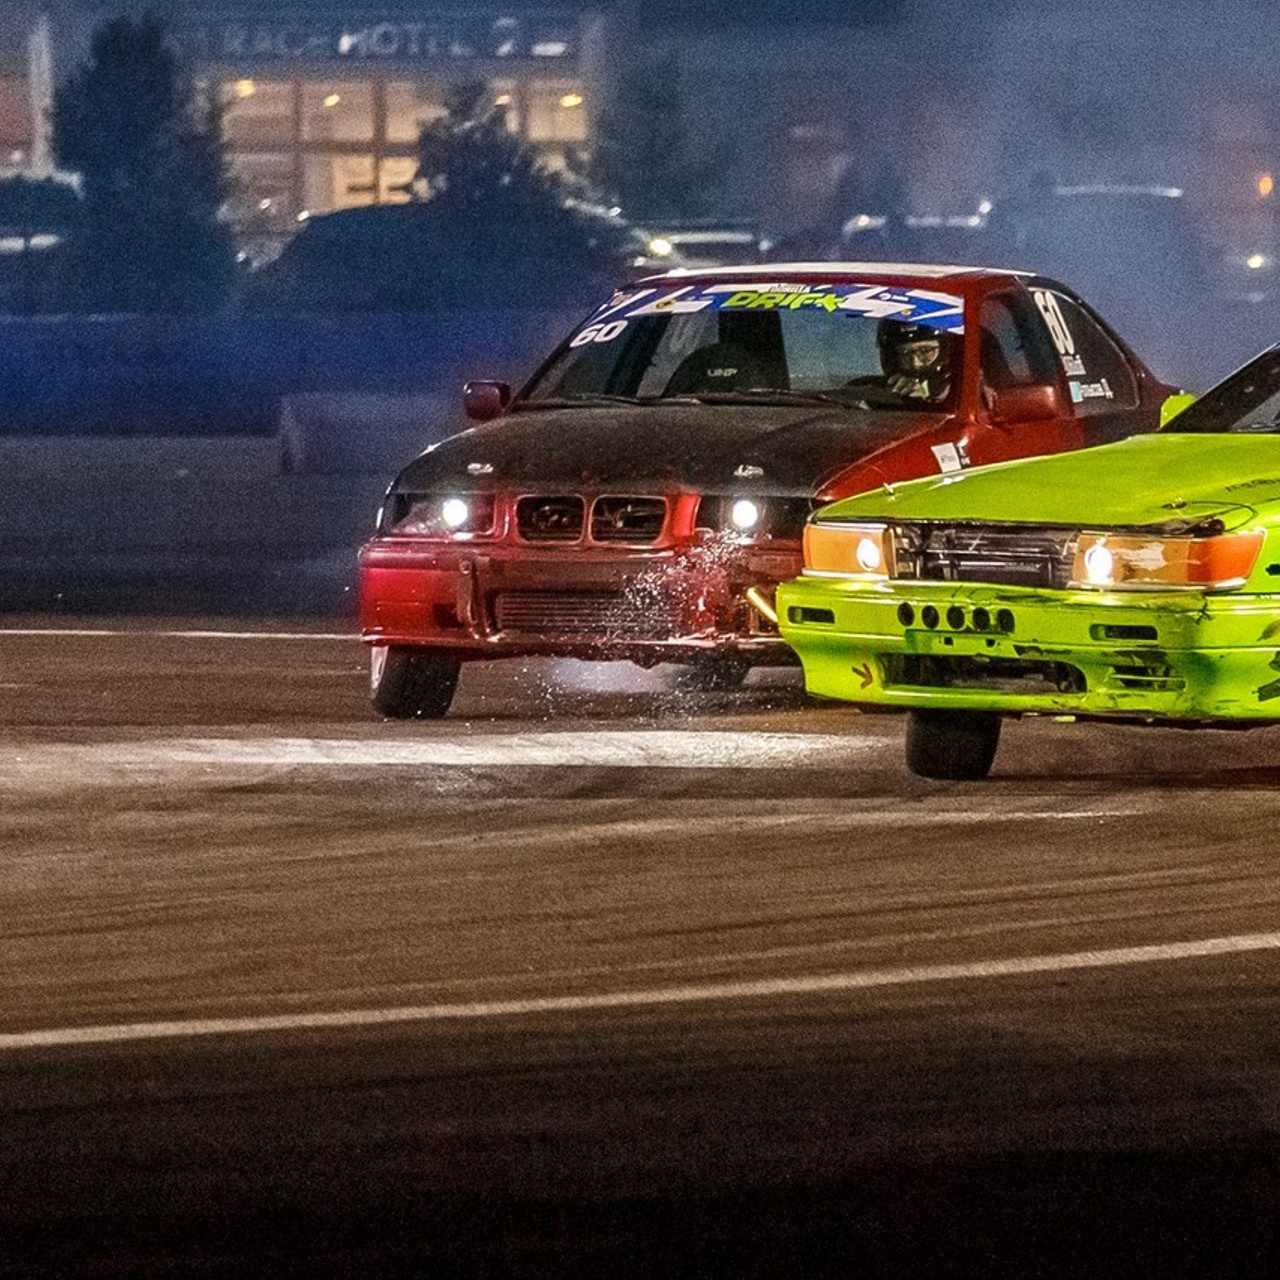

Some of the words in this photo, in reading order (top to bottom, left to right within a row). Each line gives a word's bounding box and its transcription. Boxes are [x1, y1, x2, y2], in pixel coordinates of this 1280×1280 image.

[720, 292, 845, 312] DRIFT
[569, 320, 629, 348] 60
[1033, 291, 1075, 355] 60
